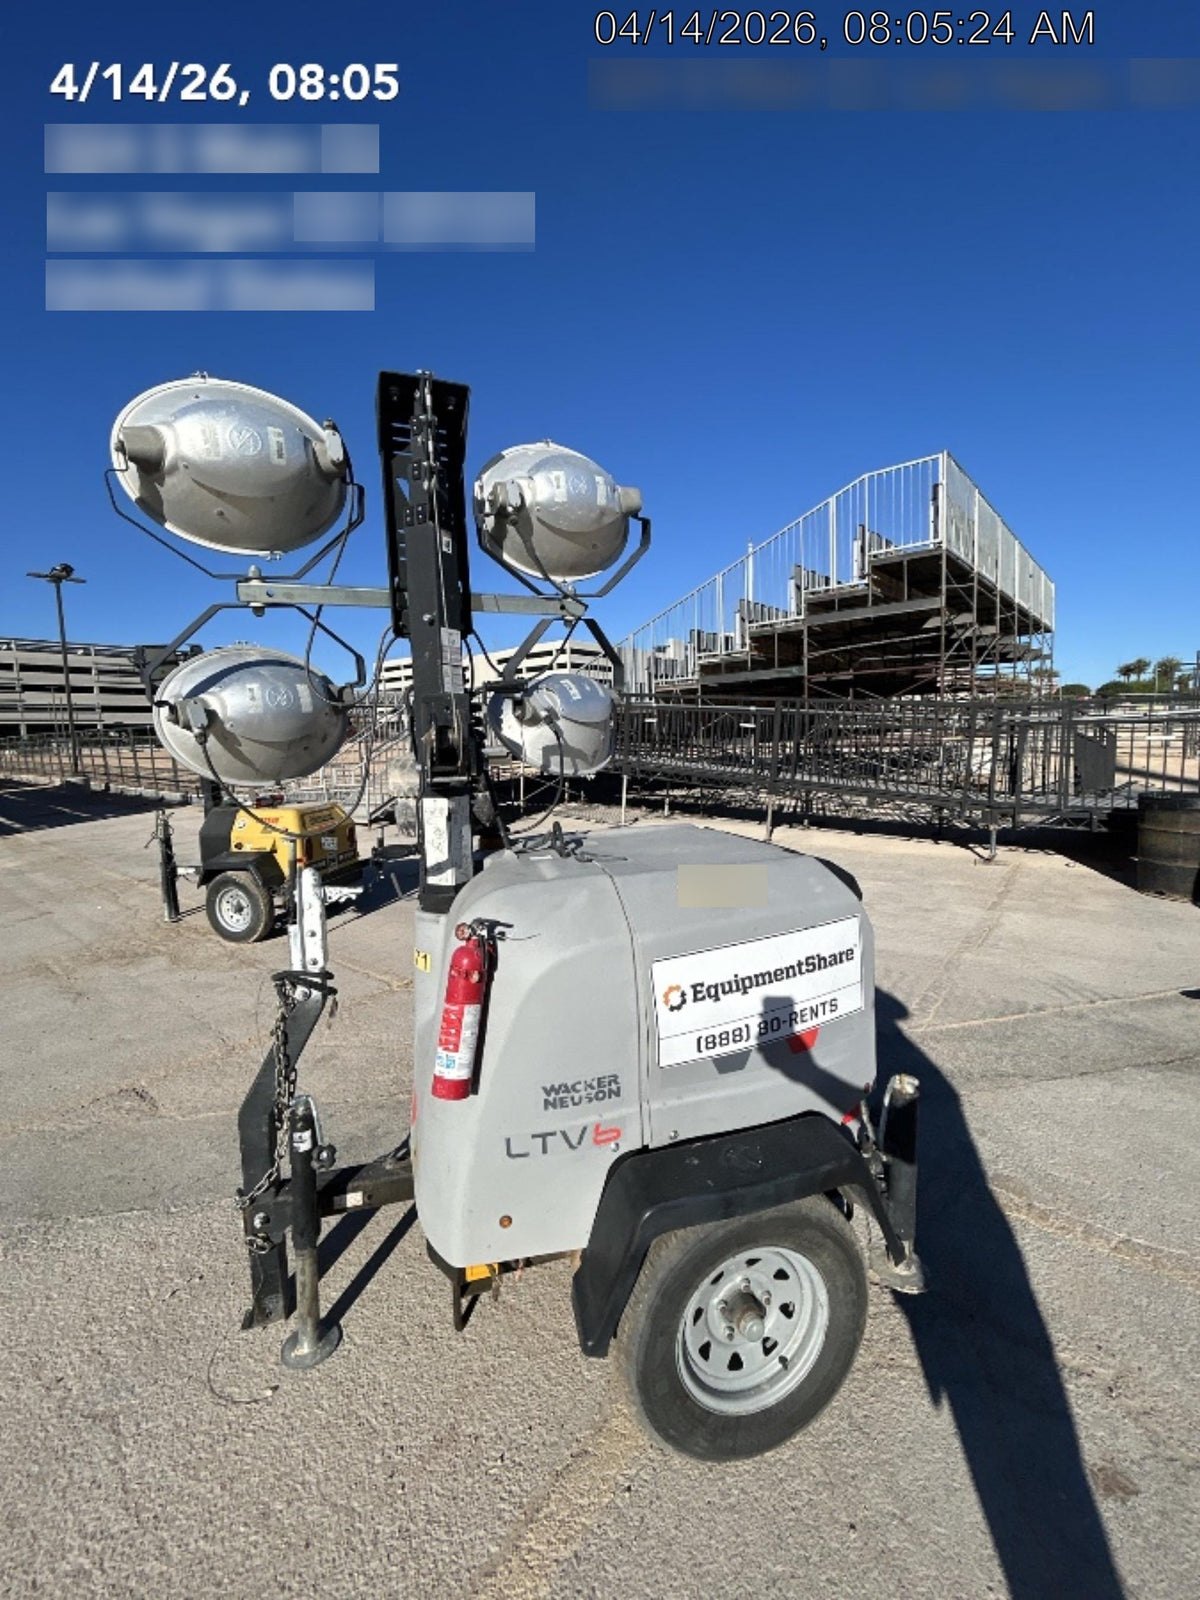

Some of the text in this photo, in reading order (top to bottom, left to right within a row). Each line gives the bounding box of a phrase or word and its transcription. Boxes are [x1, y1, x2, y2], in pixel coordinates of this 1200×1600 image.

[691, 947, 855, 1004] EquipmentShare
[697, 998, 838, 1053] (888) 80-RENTS
[542, 1074, 620, 1097] WACKER
[544, 1086, 621, 1111] NEUSON
